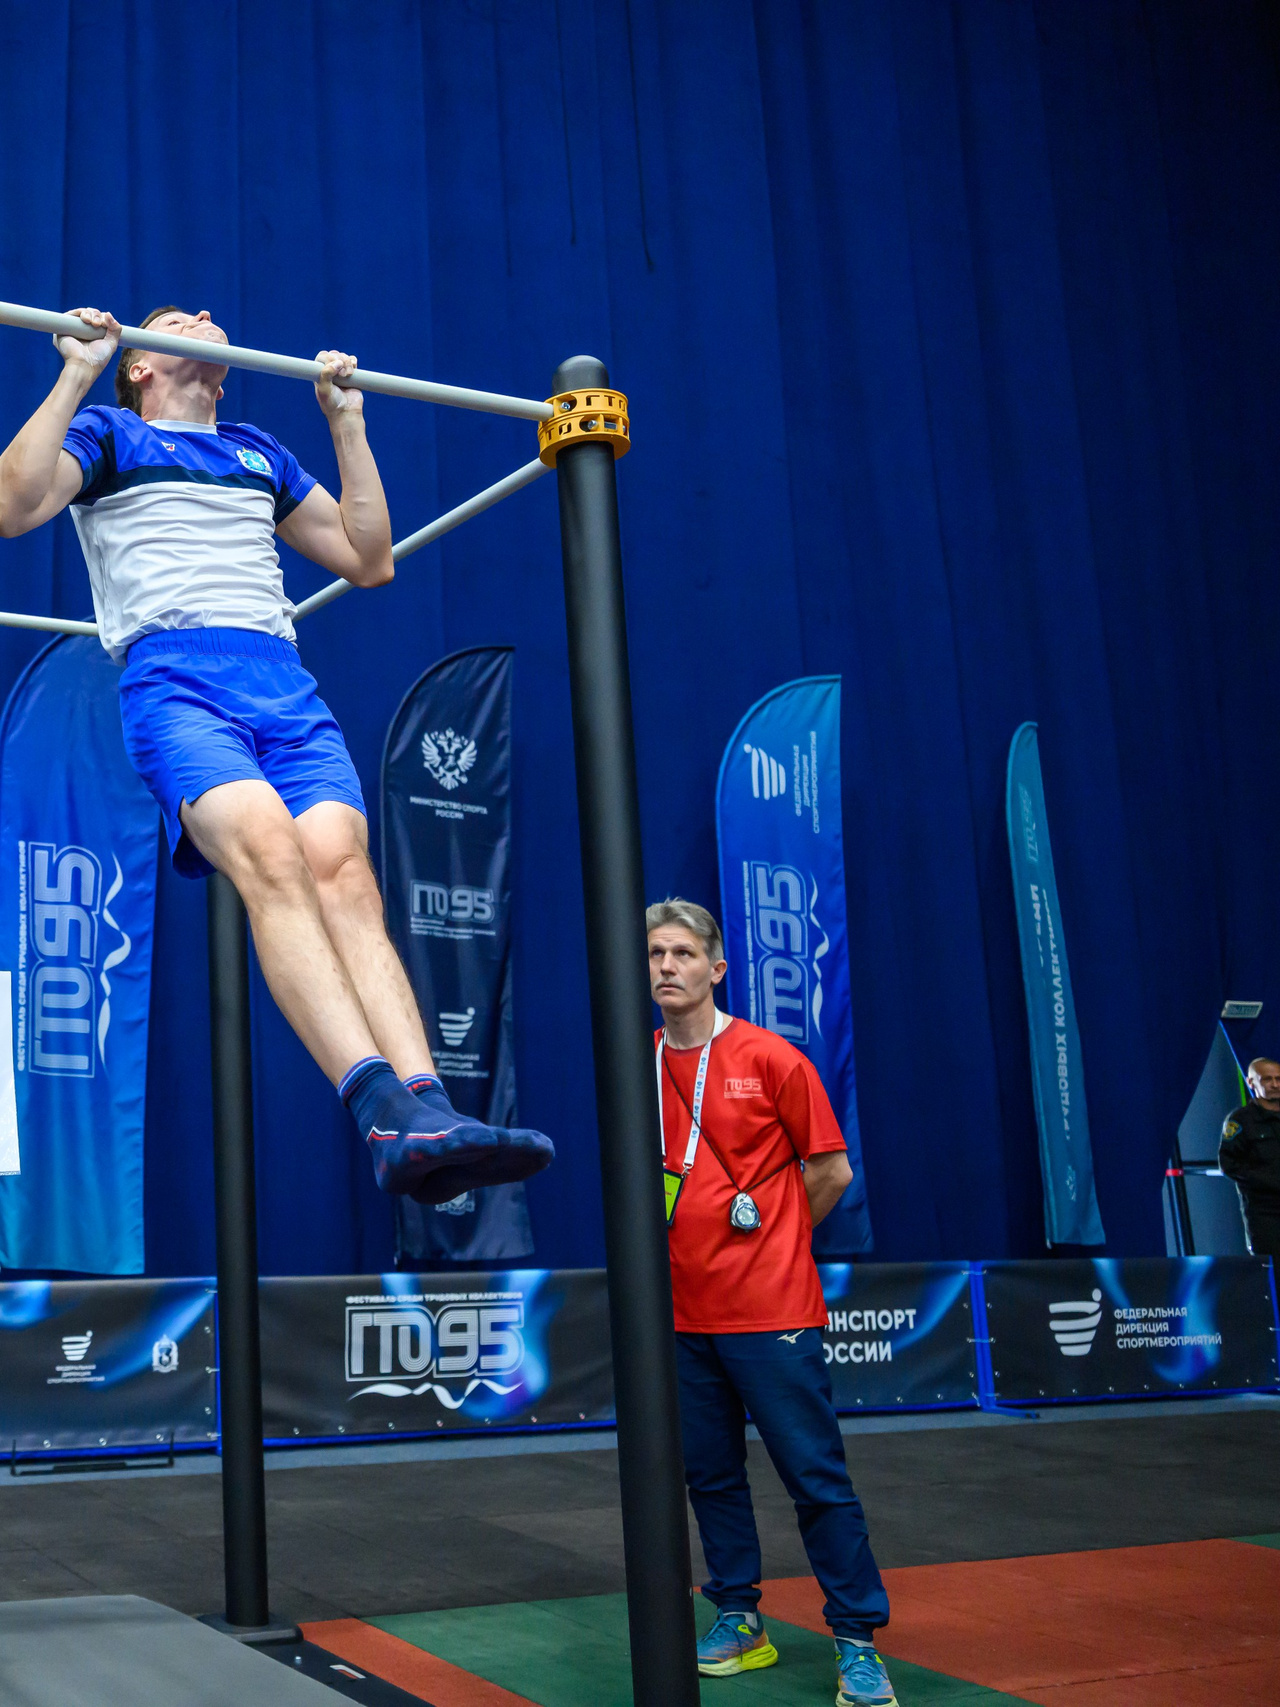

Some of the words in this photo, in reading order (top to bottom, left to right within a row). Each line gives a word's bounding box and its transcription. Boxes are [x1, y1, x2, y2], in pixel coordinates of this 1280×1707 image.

[826, 1308, 917, 1332] НСПОРТ
[1114, 1307, 1188, 1320] ФЕДЕРАЛЬНАЯ
[1116, 1322, 1169, 1336] ДИРЕКЦИЯ
[350, 1307, 520, 1375] ГТО95
[1117, 1332, 1222, 1349] СПОРТМЕРОПРИЯТИЙ
[823, 1340, 893, 1364] ОССИИ
